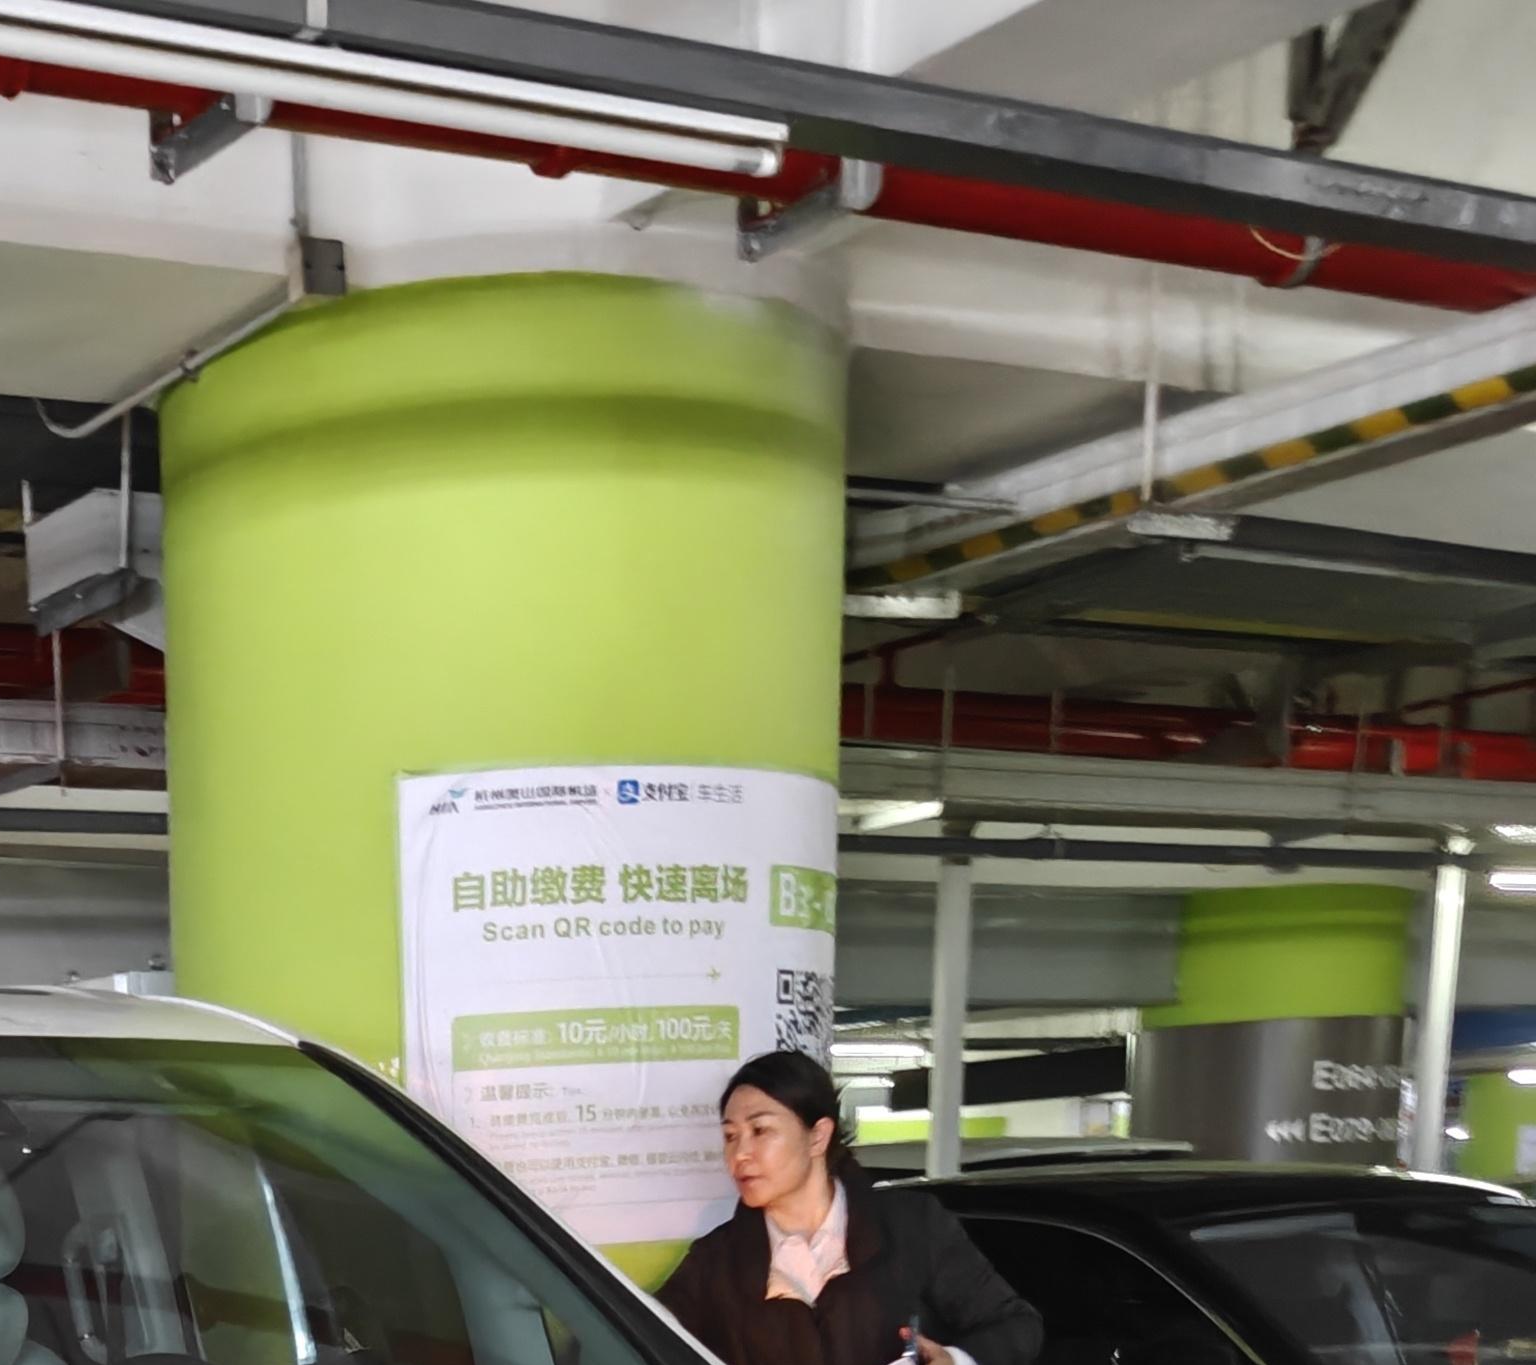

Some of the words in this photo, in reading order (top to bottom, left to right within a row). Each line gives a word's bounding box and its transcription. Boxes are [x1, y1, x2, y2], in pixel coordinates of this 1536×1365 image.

[452, 865, 607, 912] 自助缴费
[618, 863, 749, 905] 快速离场
[482, 921, 546, 942] Scan
[554, 916, 592, 938] QR
[599, 917, 656, 936] code
[663, 916, 683, 935] to
[688, 918, 727, 940] pay
